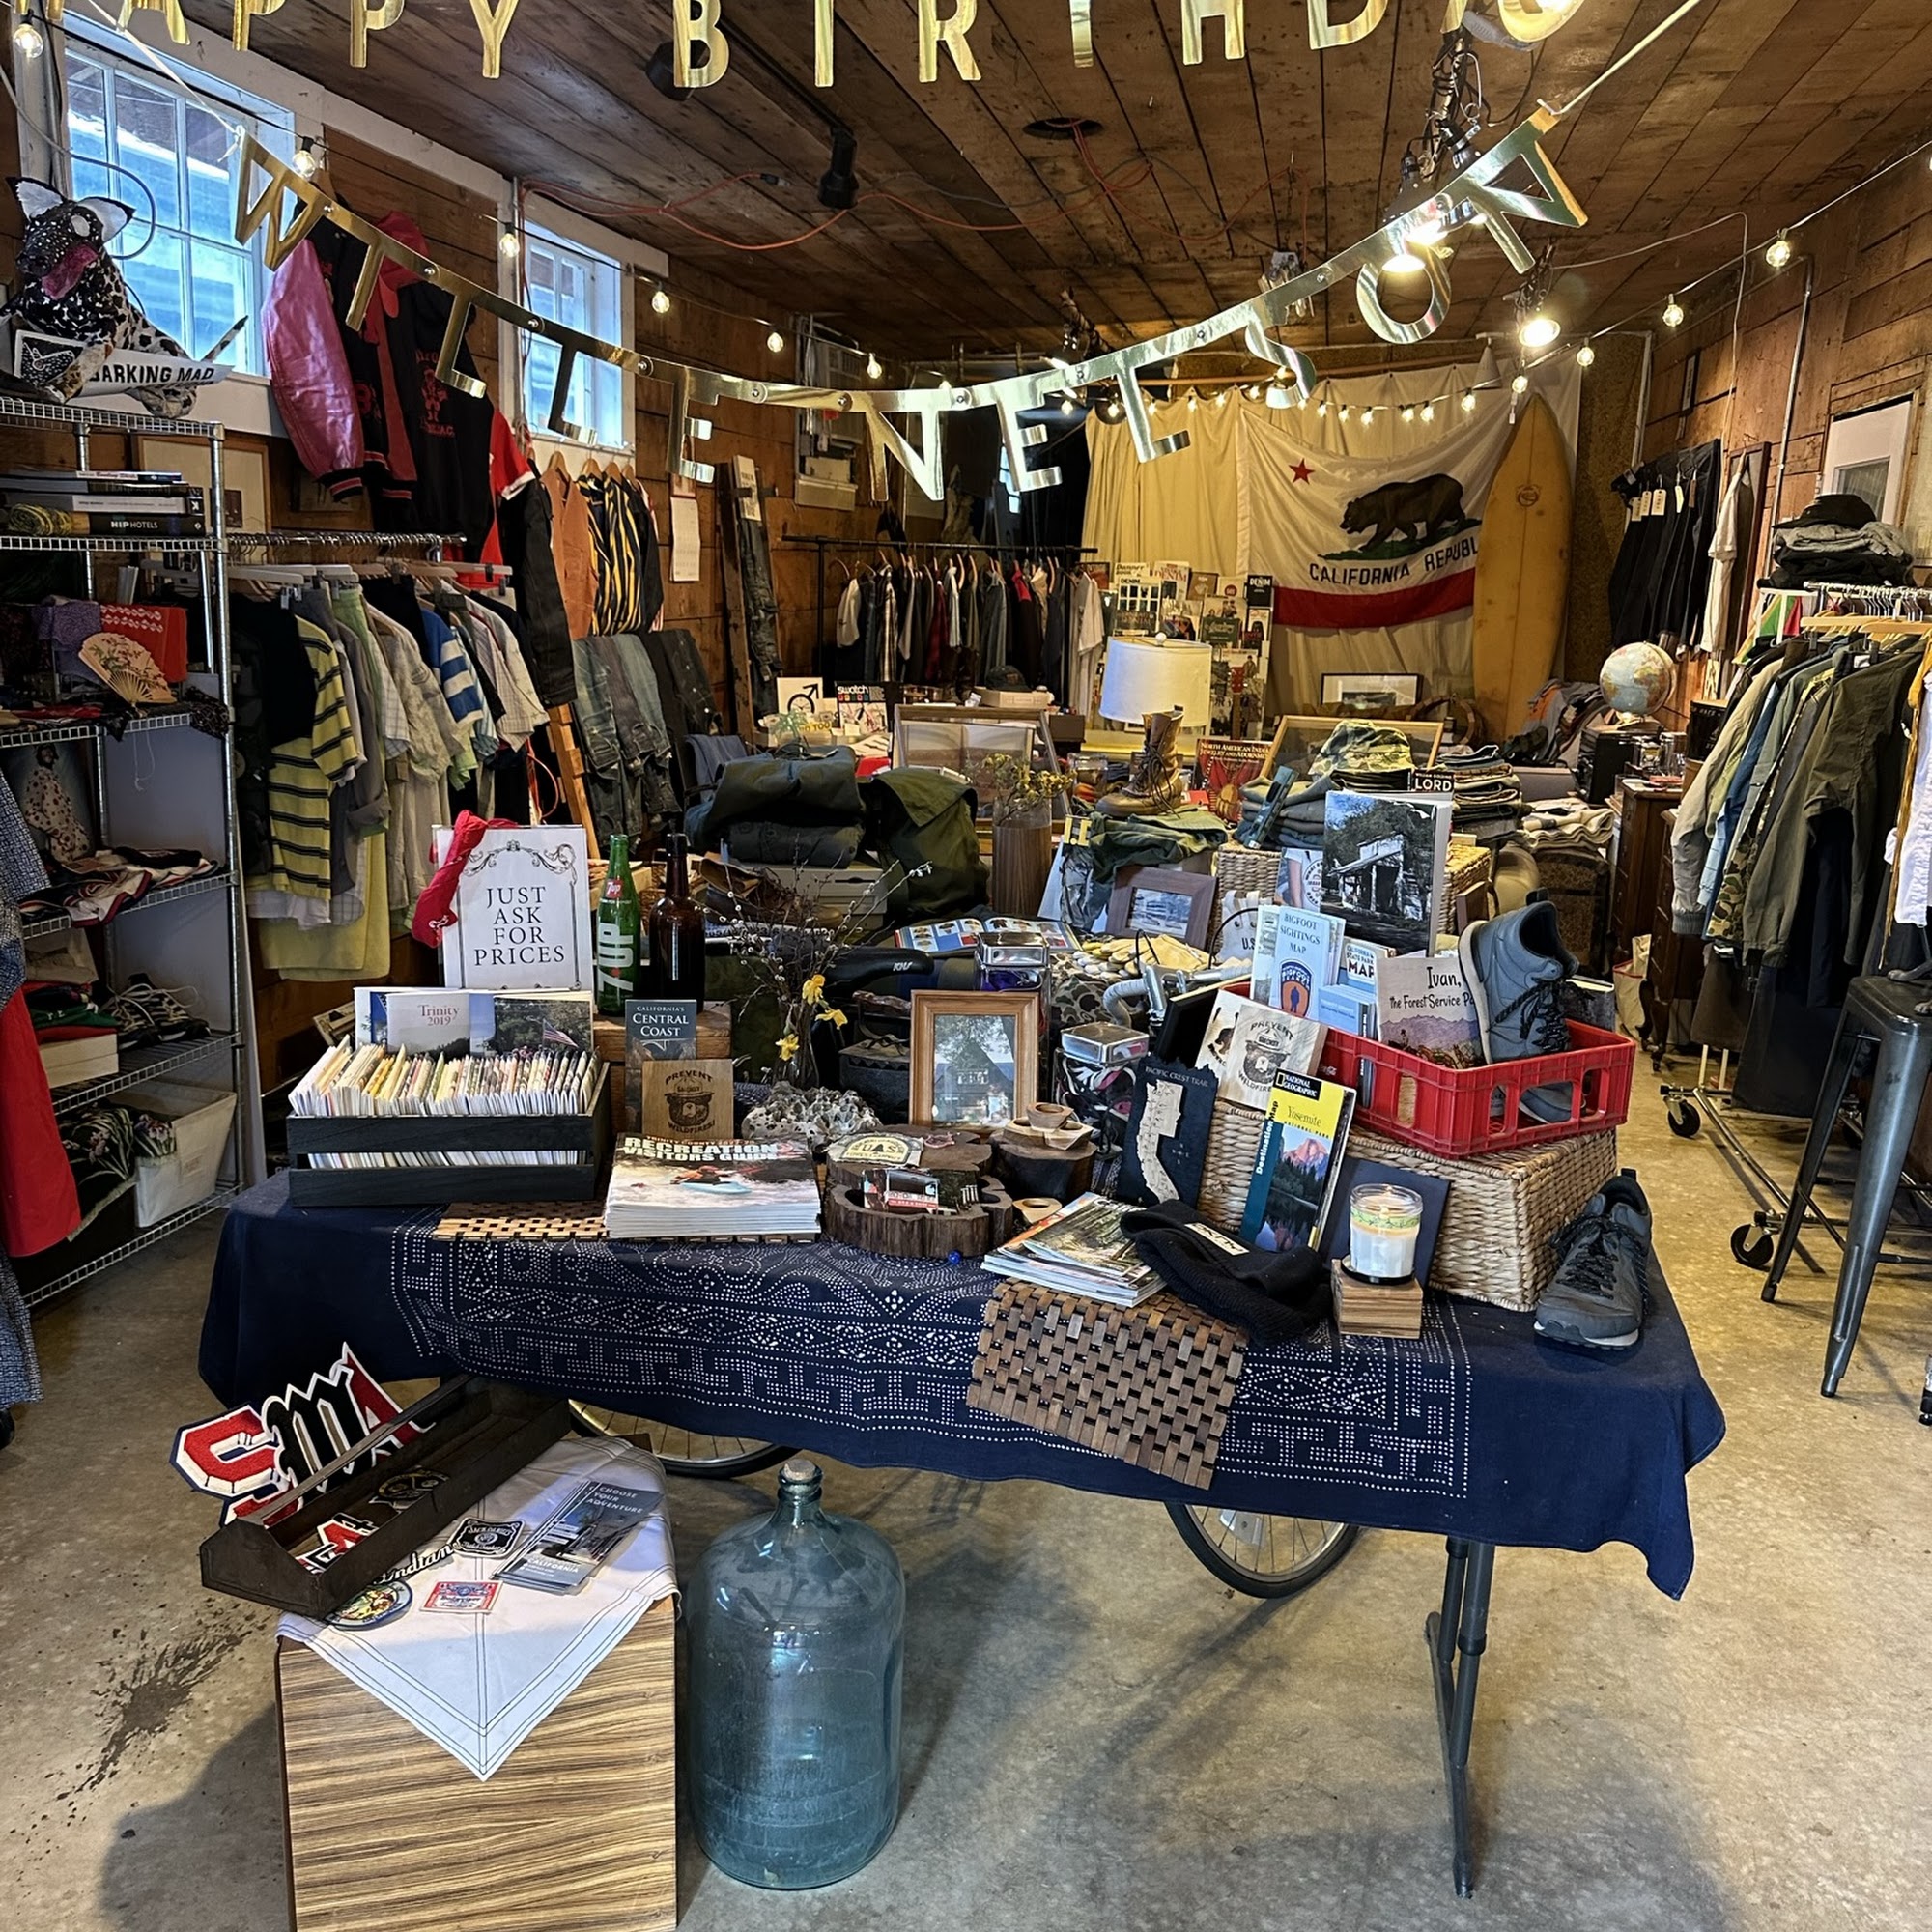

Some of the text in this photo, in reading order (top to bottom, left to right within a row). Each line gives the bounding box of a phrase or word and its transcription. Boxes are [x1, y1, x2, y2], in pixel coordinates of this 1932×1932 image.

[867, 104, 1590, 502] NELSON
[177, 367, 215, 384] MAD
[1309, 563, 1411, 586] CALIFORNIA
[837, 685, 868, 695] swatch
[1415, 778, 1452, 792] LORD
[487, 886, 546, 909] JUST
[494, 906, 543, 925] ASK
[1284, 913, 1318, 930] BIGFOOT
[494, 926, 545, 945] FOR
[1279, 925, 1321, 945] SIGHTINGS
[474, 945, 565, 966] PRICES
[1290, 942, 1306, 953] MAP
[1349, 959, 1375, 978] MAP
[1426, 966, 1462, 989] Ivan,
[1403, 995, 1427, 1009] Forest
[1428, 993, 1461, 1009] Service
[418, 1004, 460, 1017] Trinity
[632, 1013, 690, 1024] CENTRAL
[427, 1016, 452, 1027] 2019
[639, 1025, 681, 1037] COAST
[1250, 1020, 1293, 1041] PREVENT
[665, 1069, 713, 1086] PREVENT
[1145, 1065, 1168, 1078] PACIFIC
[1169, 1071, 1190, 1082] CREST
[1287, 1105, 1321, 1127] Yosemite
[624, 1136, 779, 1155] RECREATION
[1255, 1100, 1279, 1175] Destination Map
[623, 1146, 716, 1161] VISITORS
[594, 1492, 619, 1502] YOUR
[599, 1487, 638, 1498] CHOOSE
[586, 1498, 644, 1514] ADVENTURE
[527, 1558, 579, 1573] CALIFORNIA
